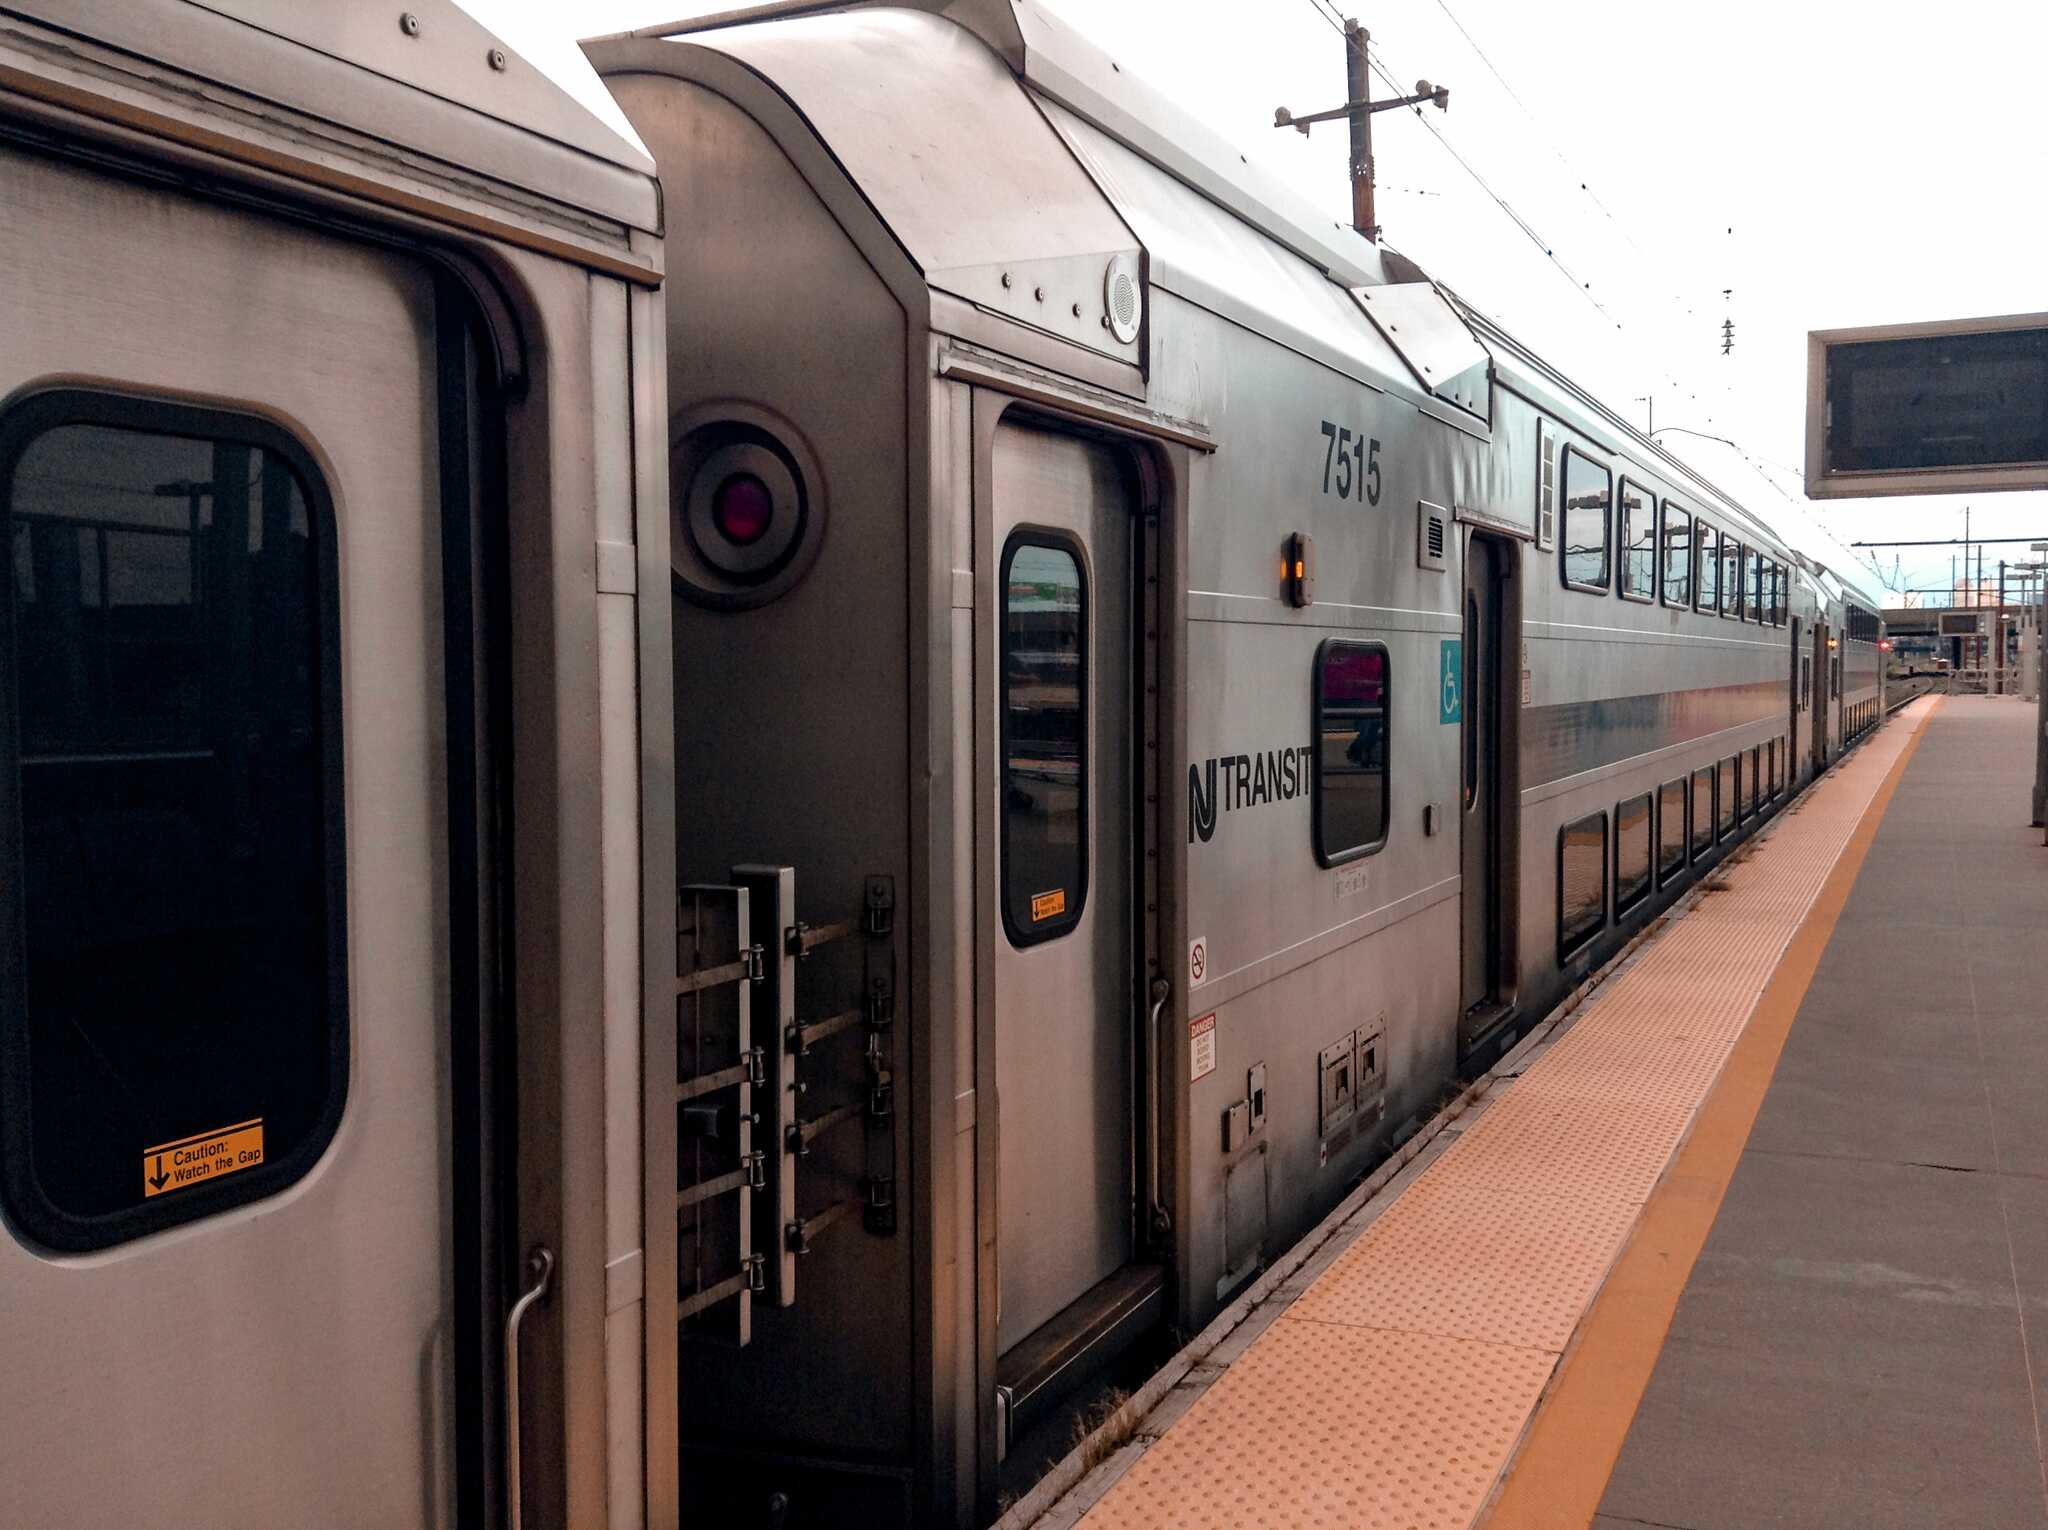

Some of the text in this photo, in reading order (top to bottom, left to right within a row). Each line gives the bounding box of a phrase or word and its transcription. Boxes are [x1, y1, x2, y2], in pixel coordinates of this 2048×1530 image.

[1321, 420, 1381, 507] 7515
[1220, 746, 1313, 812] TRANSIT
[1191, 1016, 1215, 1037] DANGER
[173, 1141, 229, 1165] Caution:
[173, 1149, 261, 1183] Watch the Gap
